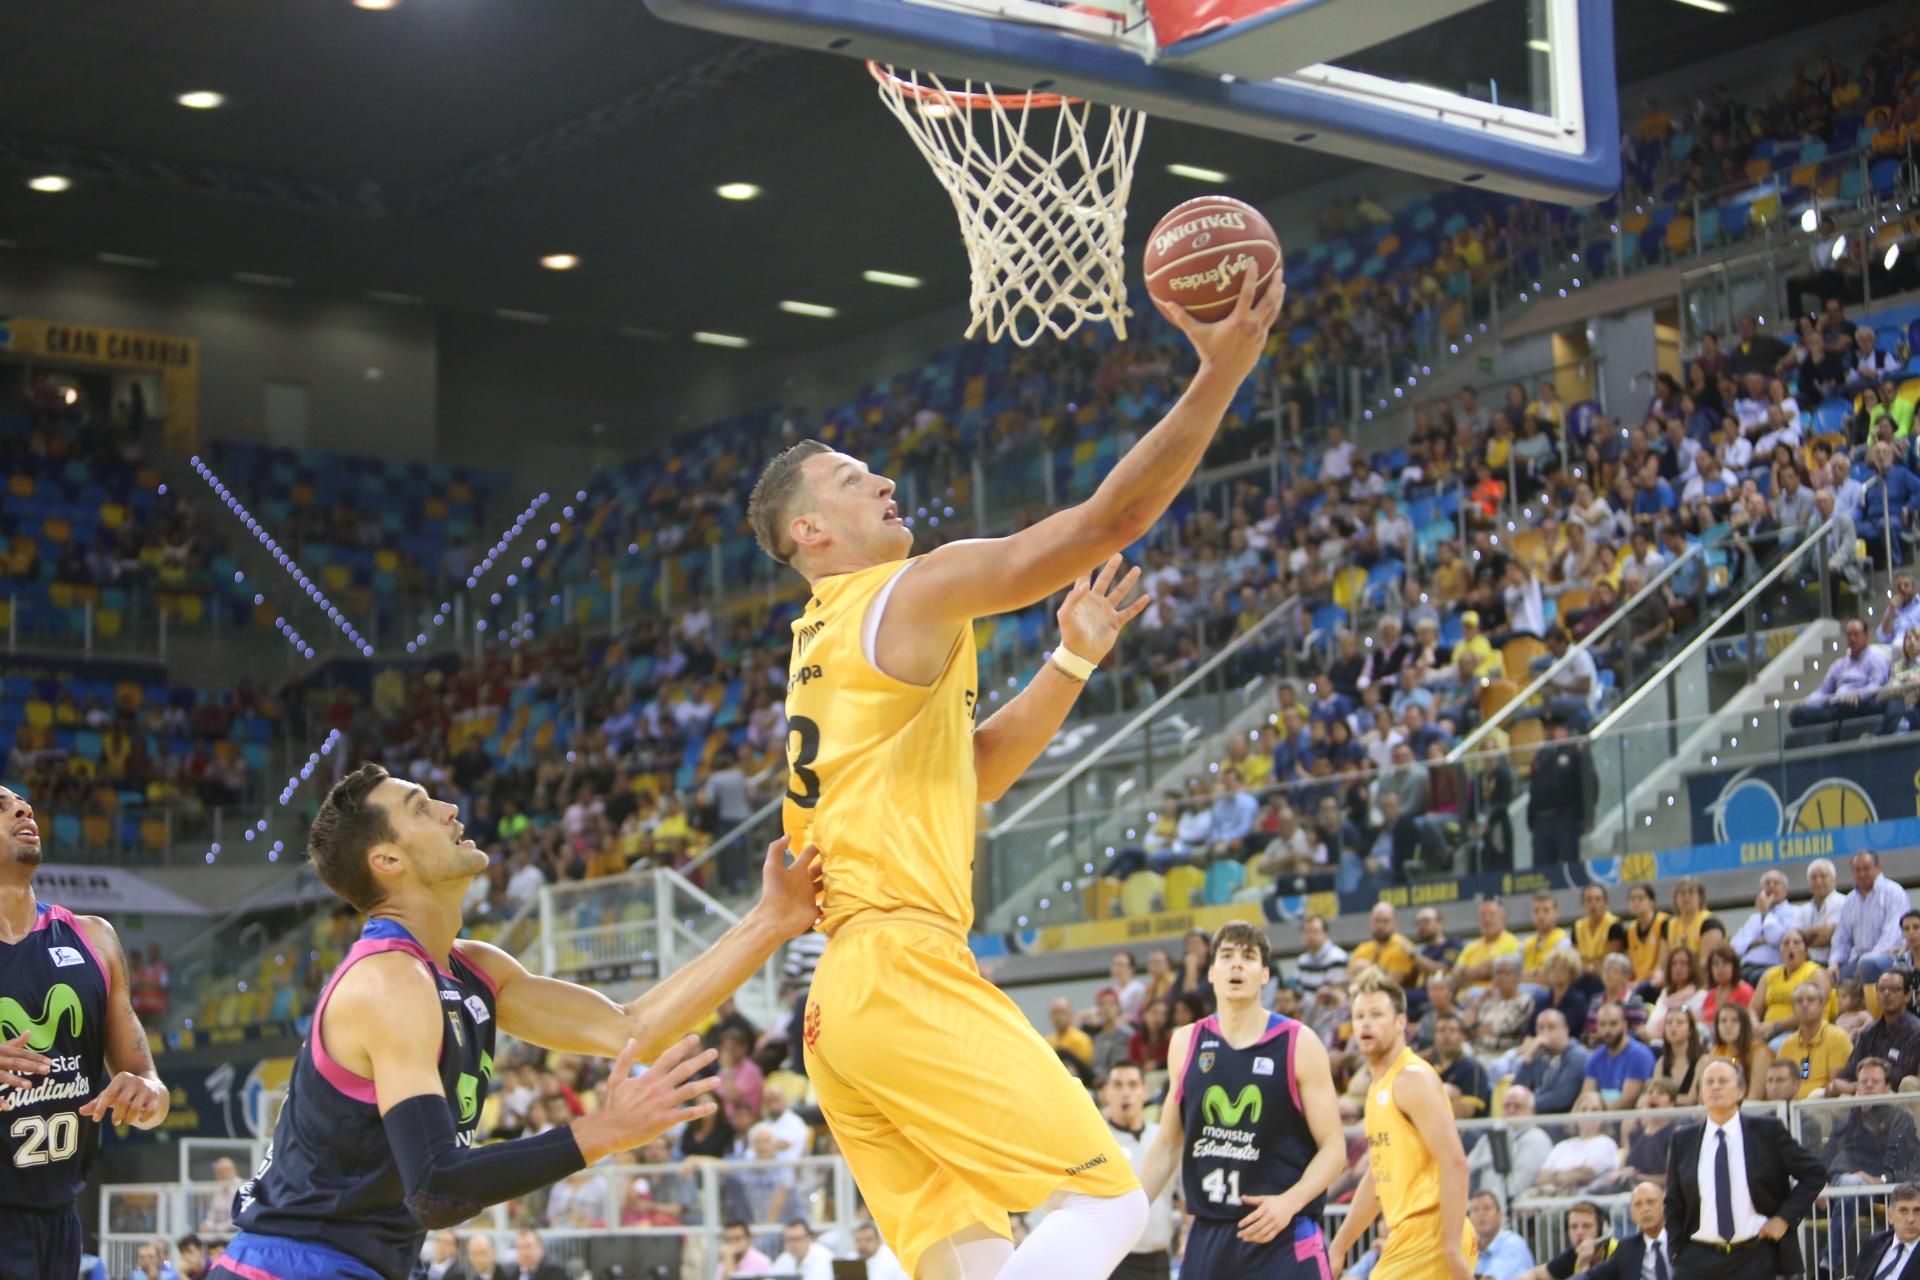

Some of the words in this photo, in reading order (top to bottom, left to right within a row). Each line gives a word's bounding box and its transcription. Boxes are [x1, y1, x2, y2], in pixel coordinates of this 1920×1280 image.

[1155, 212, 1246, 256] SPALDING
[1740, 841, 1774, 864] GRAN
[1778, 833, 1834, 860] CANARIA
[11, 1111, 79, 1168] 20
[1192, 1138, 1260, 1161] Estudiantes
[1202, 1126, 1256, 1143] movistar
[1202, 1168, 1242, 1206] 41
